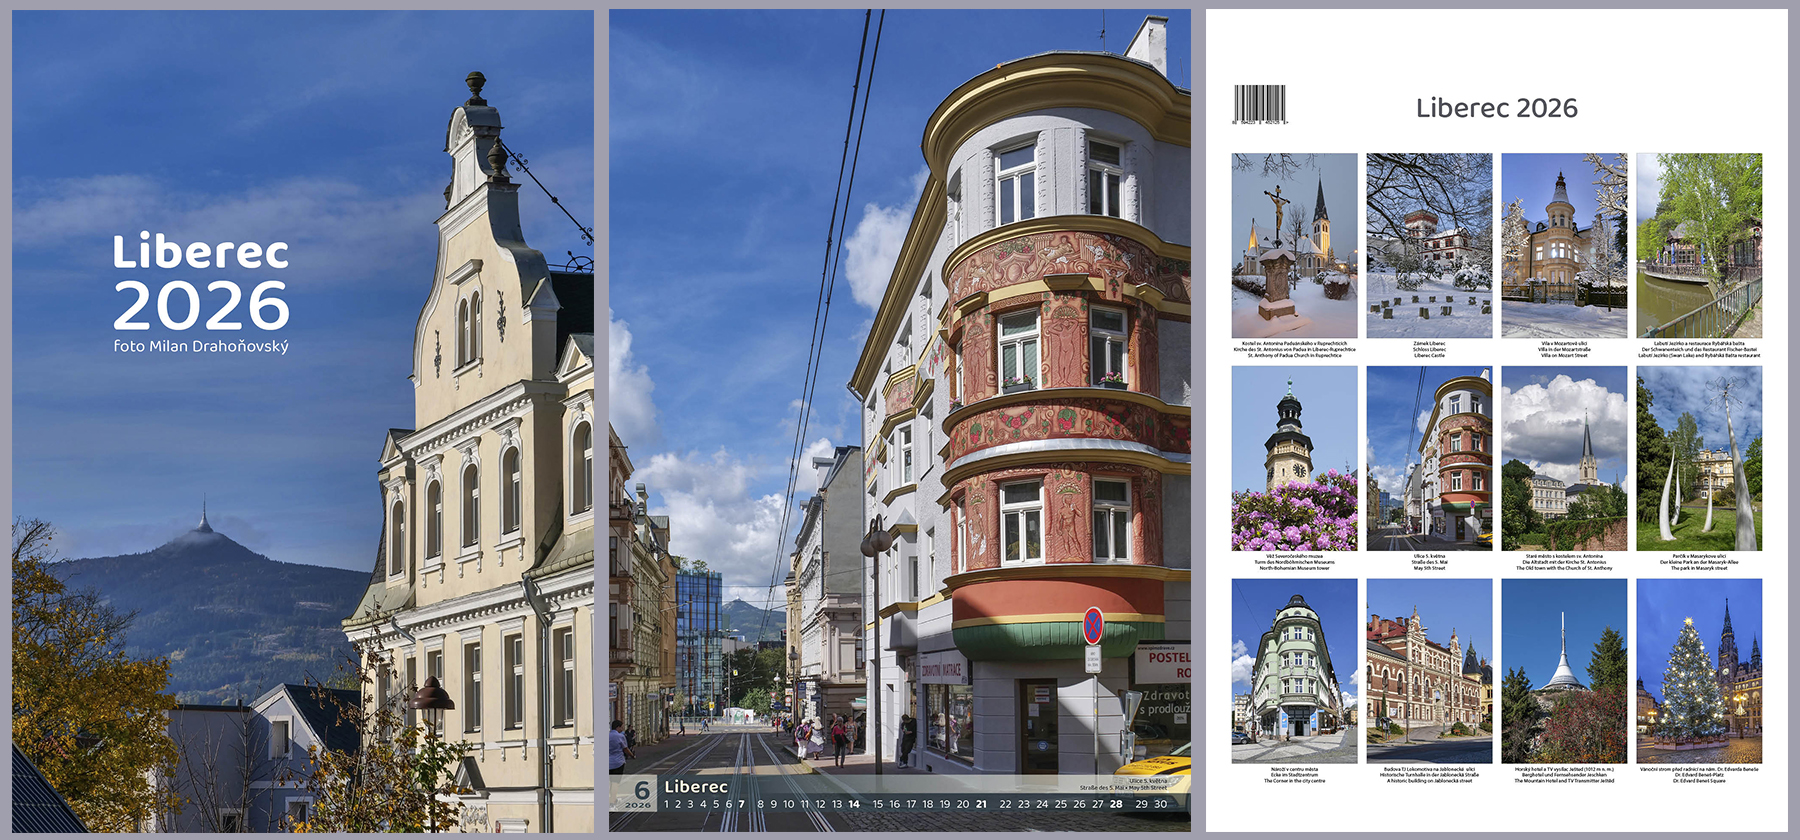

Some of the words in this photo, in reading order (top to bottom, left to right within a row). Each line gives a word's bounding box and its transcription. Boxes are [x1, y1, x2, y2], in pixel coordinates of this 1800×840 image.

[943, 663, 961, 676] MATRACE
[1144, 690, 1190, 700] Zdravot
[1140, 706, 1145, 714] s
